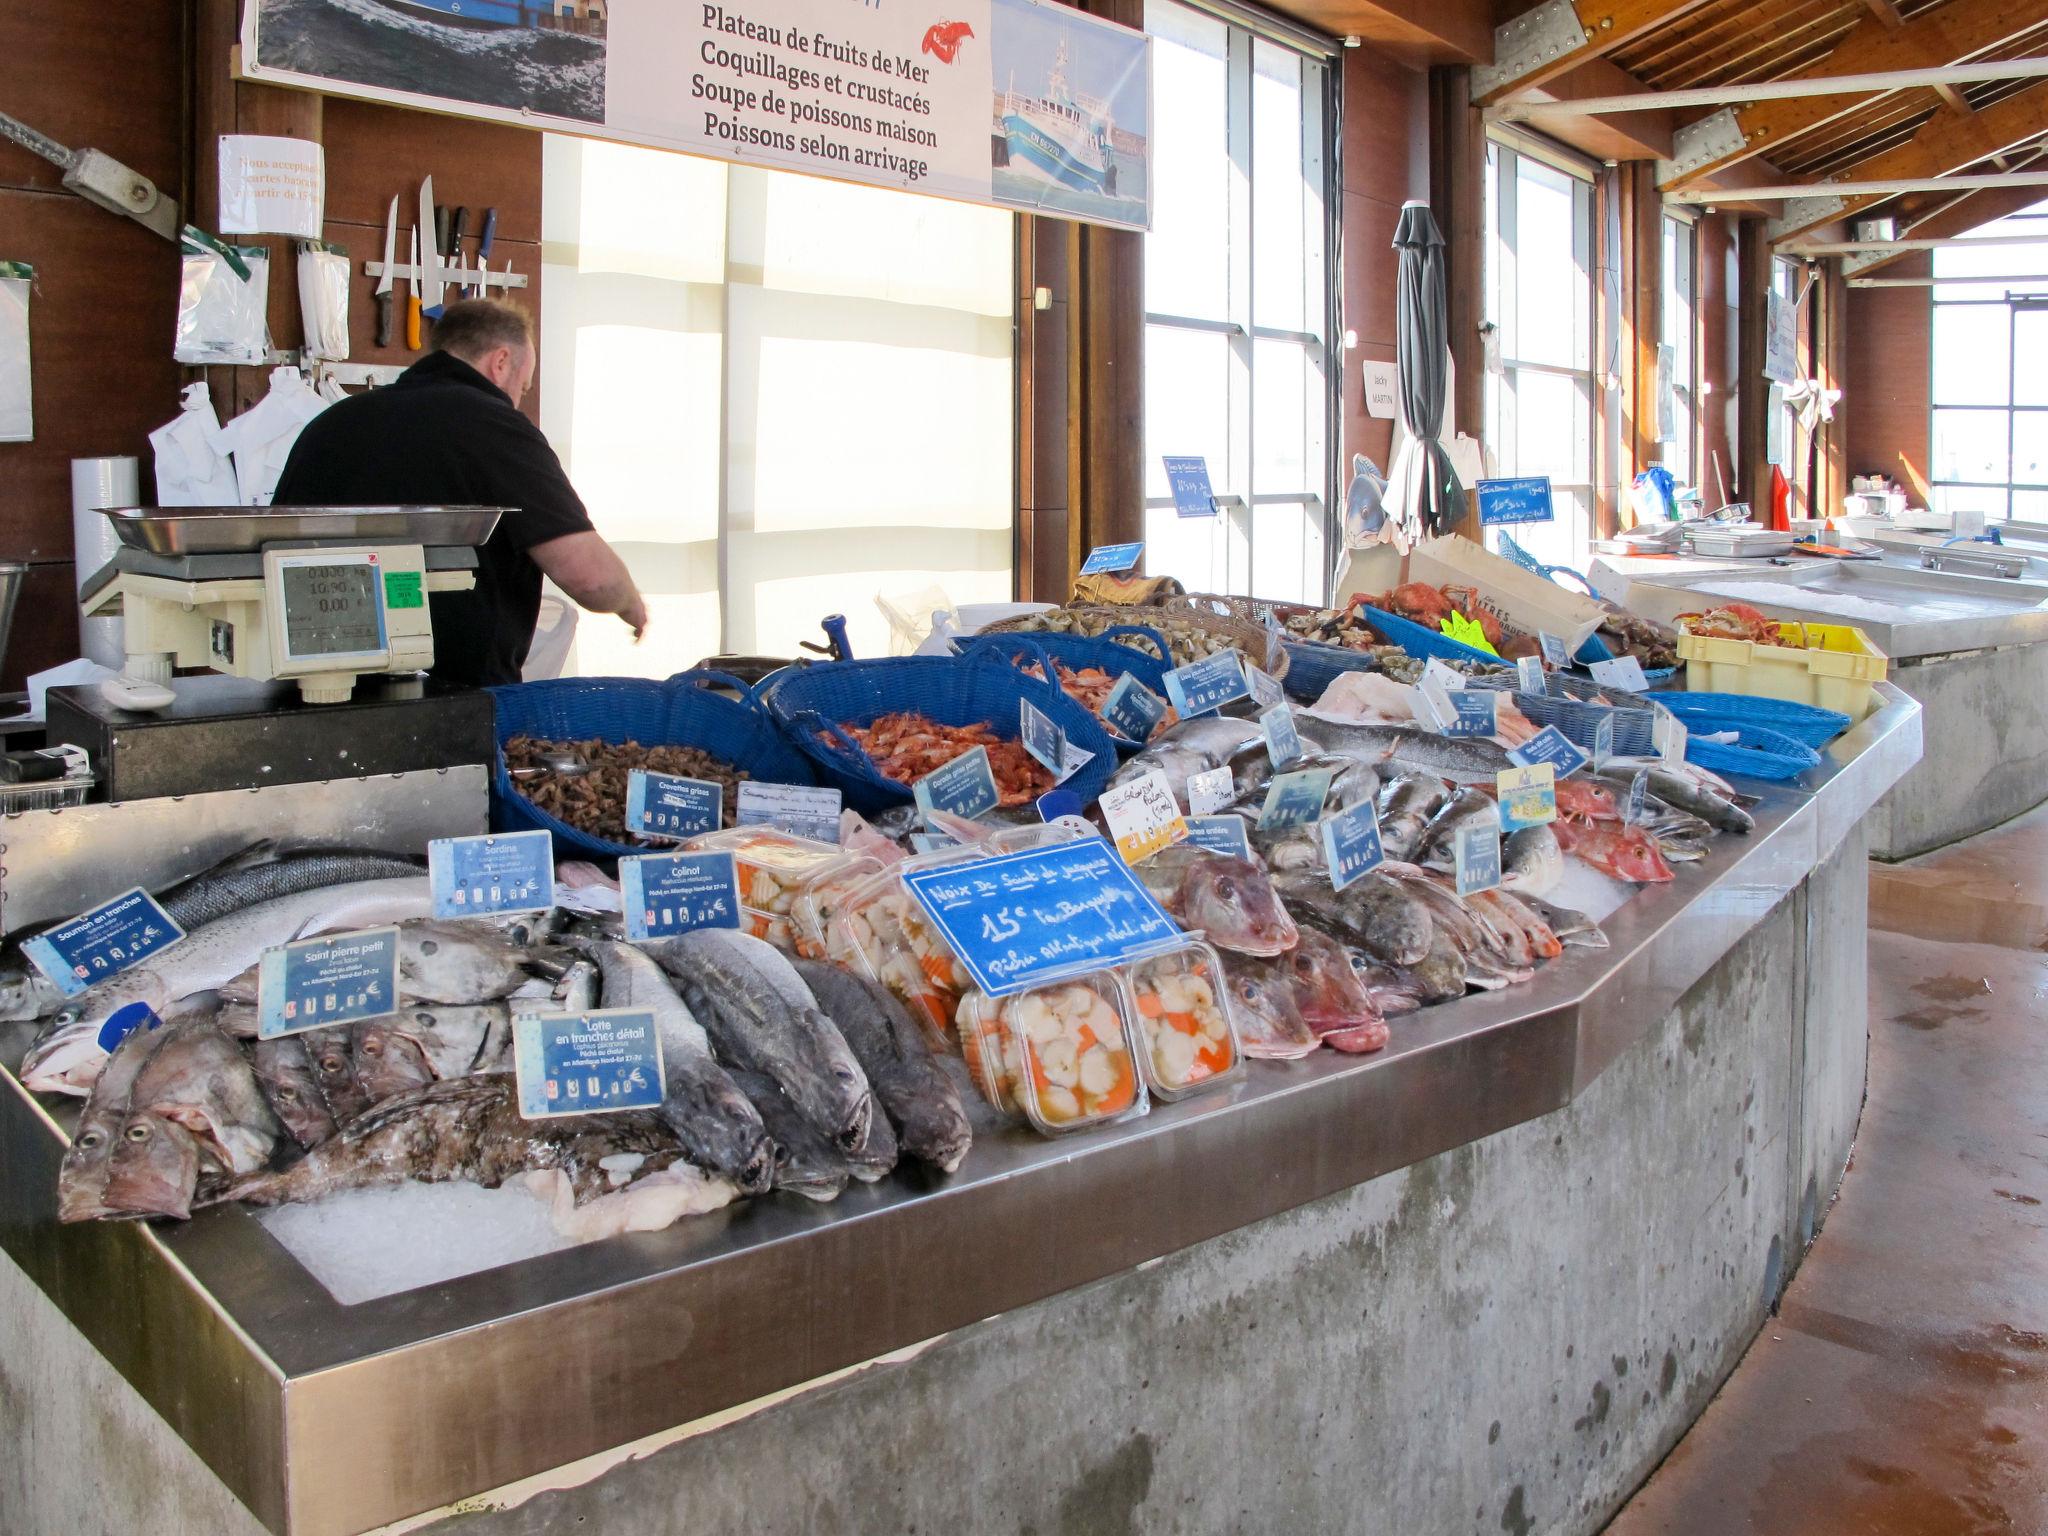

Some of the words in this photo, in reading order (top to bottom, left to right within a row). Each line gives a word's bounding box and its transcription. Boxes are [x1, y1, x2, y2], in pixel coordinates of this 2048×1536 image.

[702, 4, 781, 46] Plateau
[787, 28, 808, 53] de
[813, 33, 868, 68] fruits
[872, 50, 892, 74] de
[895, 56, 930, 84] Mer
[701, 40, 820, 90] Coquillages
[824, 74, 842, 95] et
[847, 81, 930, 115] crustacés
[691, 73, 756, 112] Soupe
[762, 90, 786, 115] de
[790, 100, 872, 134] poissons
[877, 120, 937, 148] maison
[704, 112, 795, 151] Poissons
[800, 135, 850, 162] selon
[854, 147, 928, 181] arrivage
[671, 866, 701, 877] Colinot
[928, 884, 971, 904] Noix
[1001, 869, 1039, 888] Saint
[57, 921, 94, 941] Saumon
[94, 914, 106, 924] en
[105, 896, 142, 918] tranches
[305, 949, 329, 962] Saint
[331, 946, 360, 960] pierre
[361, 940, 384, 955] petit
[556, 1035, 569, 1045] en
[571, 1030, 614, 1044] tranches
[616, 1027, 645, 1040] détail
[586, 1020, 612, 1032] Lotte
